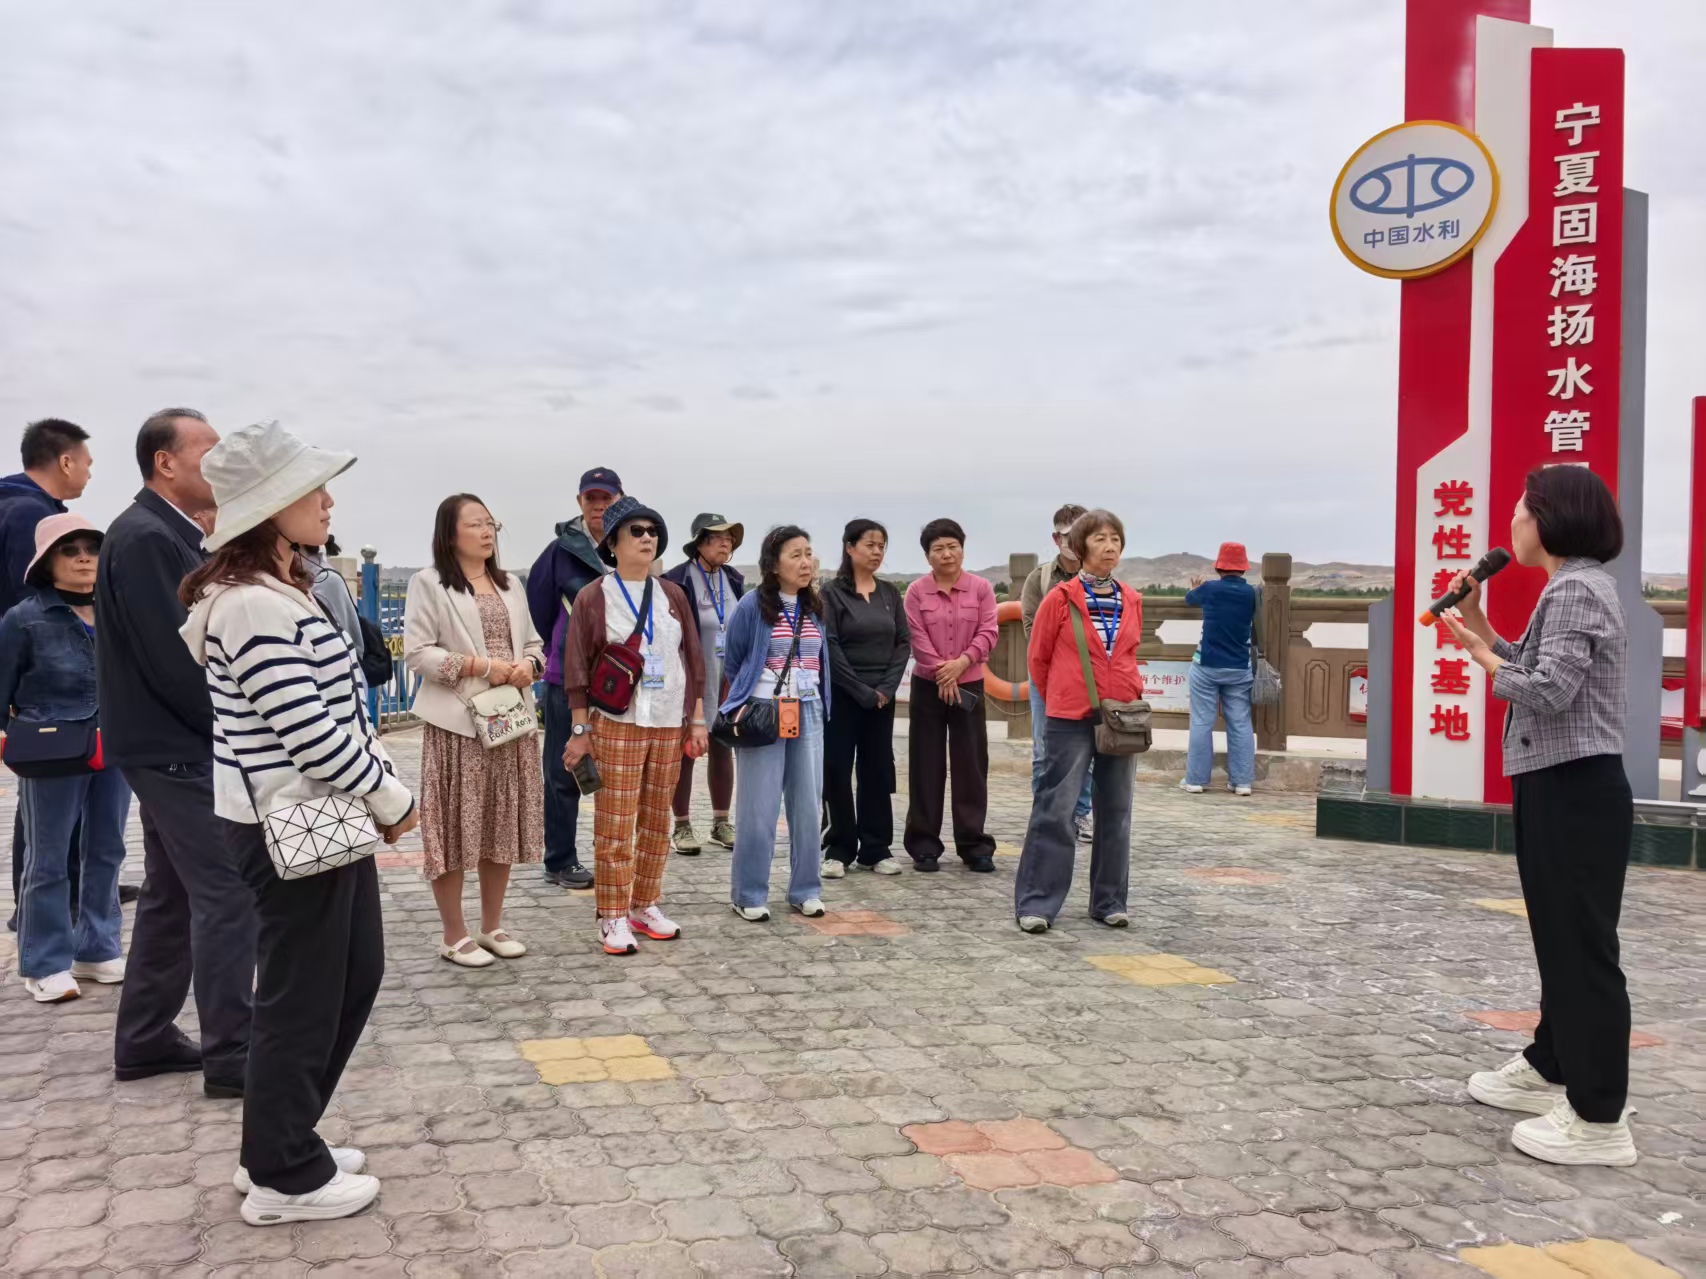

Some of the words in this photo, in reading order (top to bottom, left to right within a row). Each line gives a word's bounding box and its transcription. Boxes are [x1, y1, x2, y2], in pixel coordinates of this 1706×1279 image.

[1364, 219, 1460, 249] 中国水利
[1543, 102, 1600, 469] 宁夏固海扬水管
